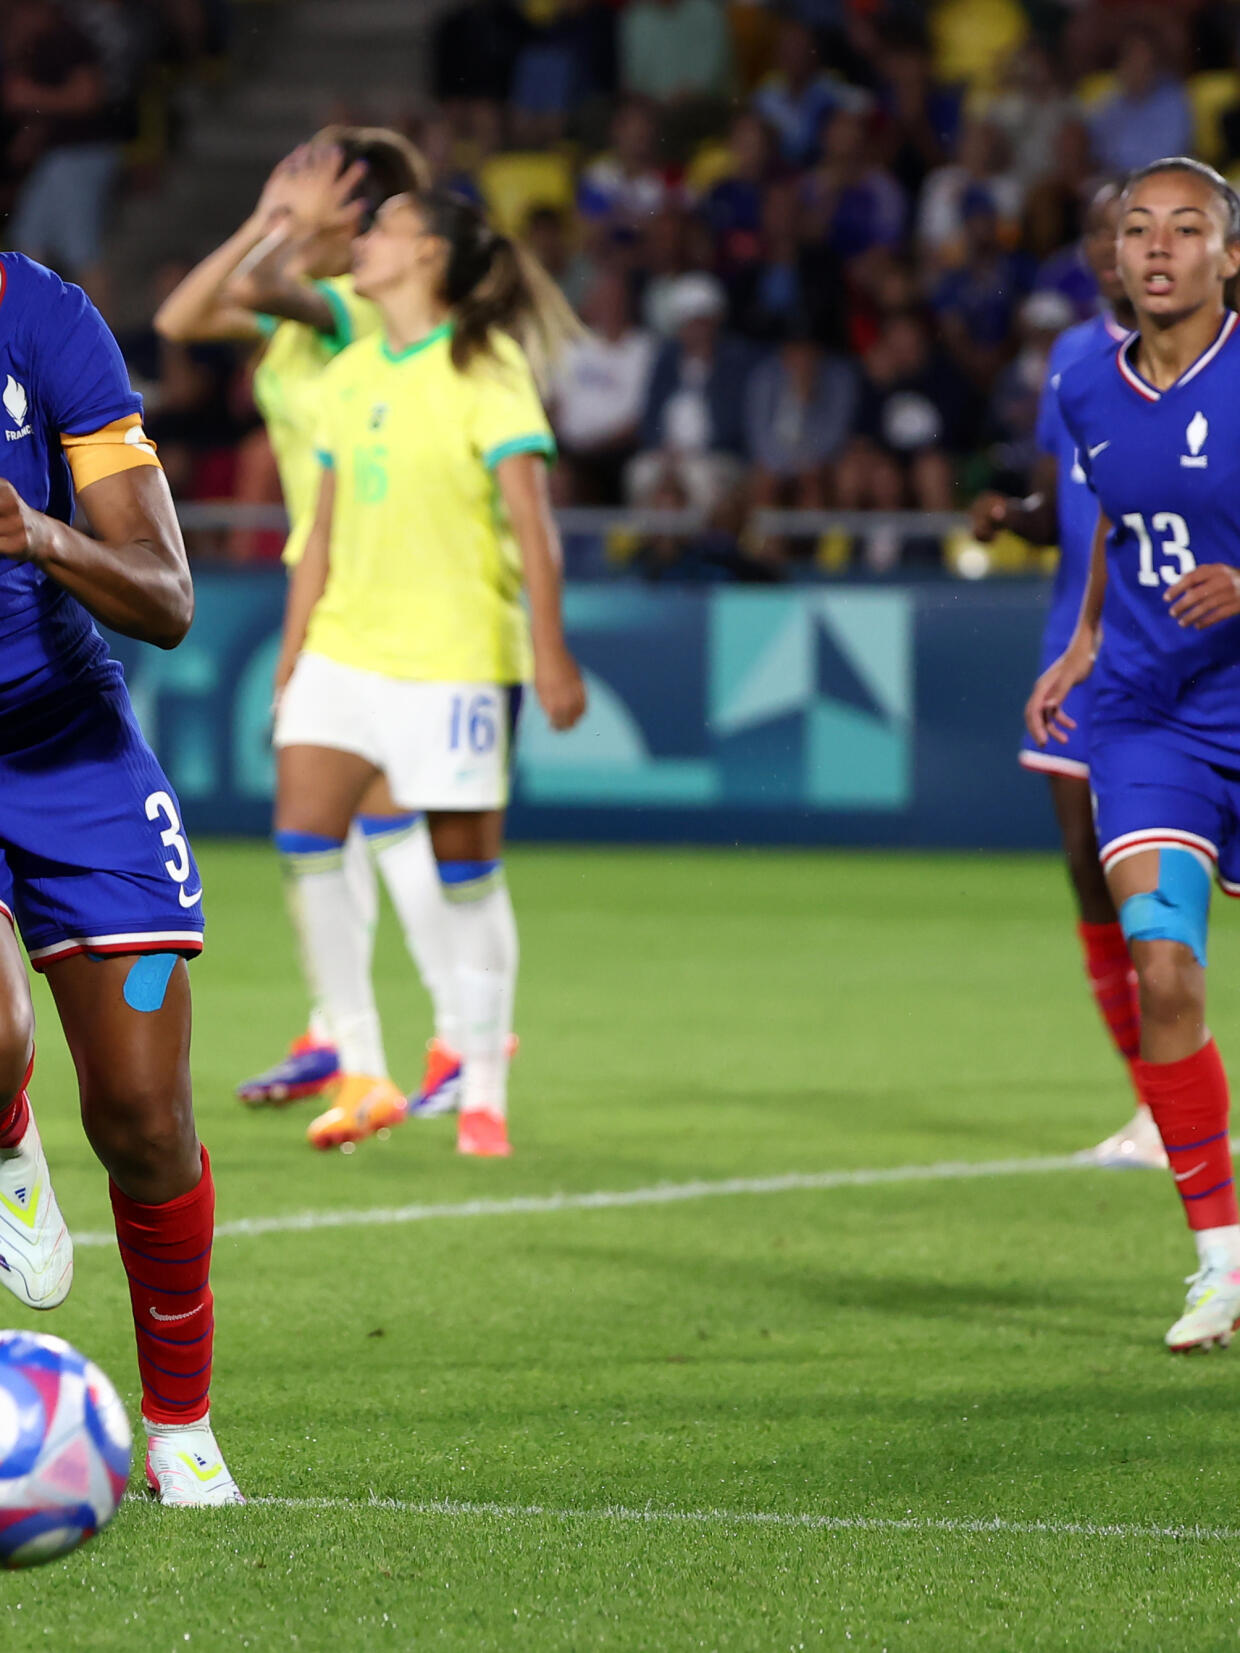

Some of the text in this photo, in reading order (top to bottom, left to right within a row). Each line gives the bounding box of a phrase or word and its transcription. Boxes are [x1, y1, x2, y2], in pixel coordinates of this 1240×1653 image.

[5, 424, 35, 441] FRANC
[352, 444, 389, 505] 16
[1122, 511, 1197, 587] 13
[449, 694, 496, 755] 16
[145, 791, 189, 882] 3
